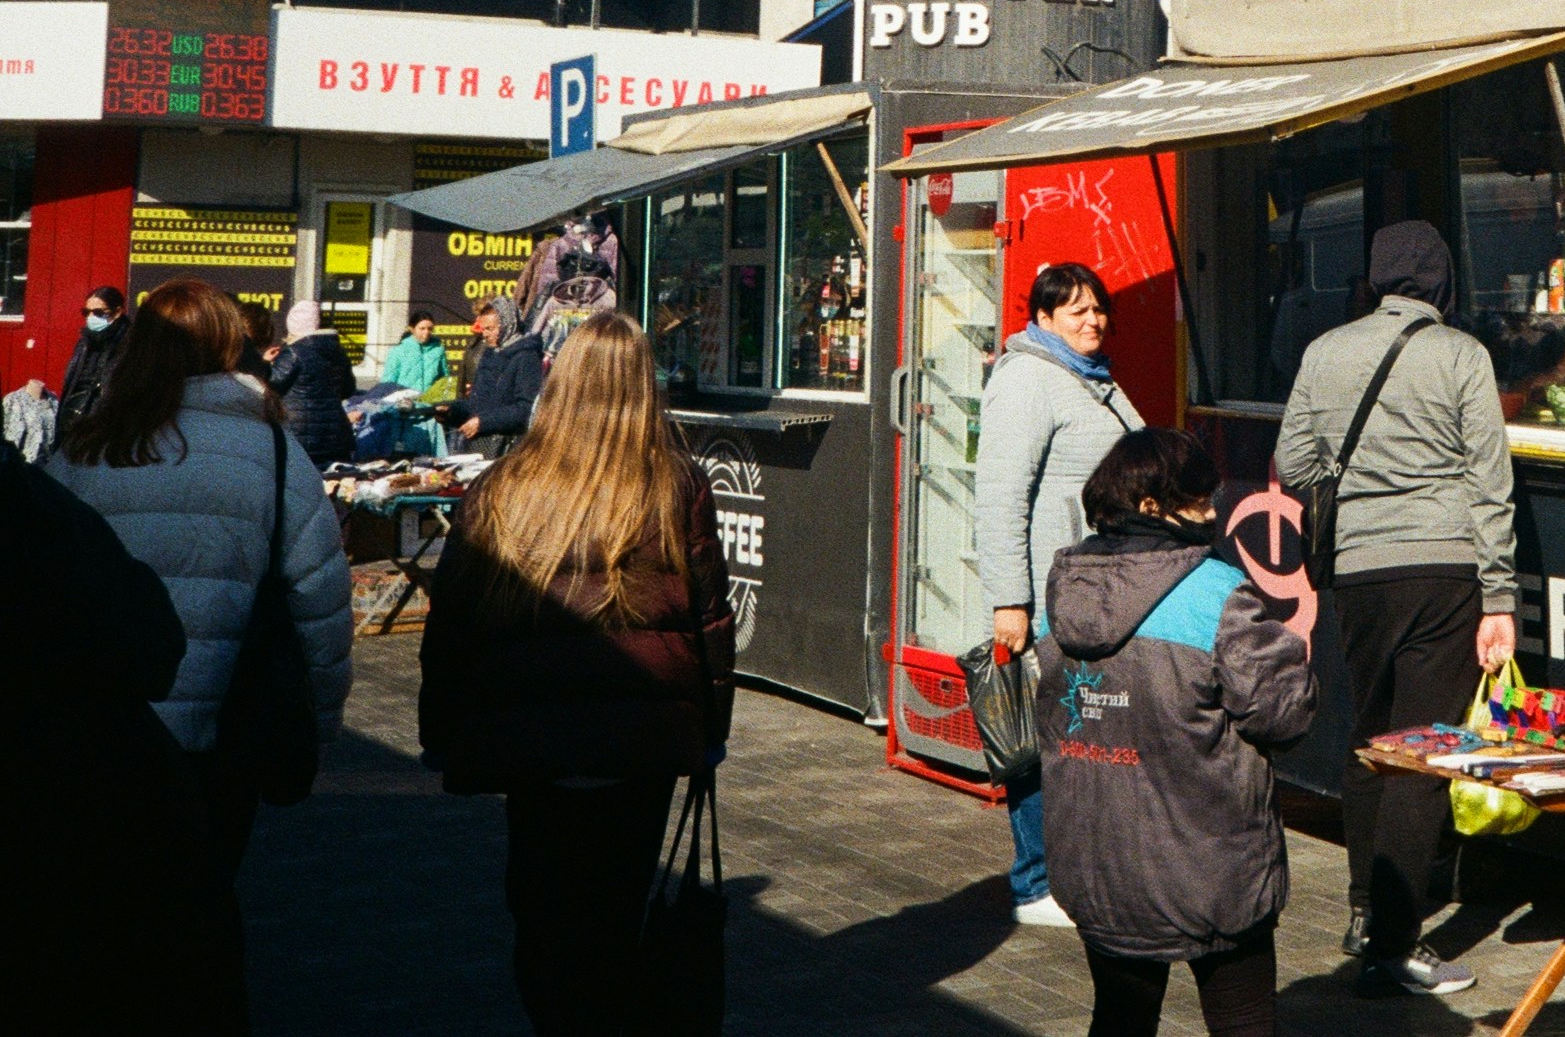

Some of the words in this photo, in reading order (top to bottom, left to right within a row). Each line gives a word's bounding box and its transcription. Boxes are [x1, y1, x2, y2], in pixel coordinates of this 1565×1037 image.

[870, 2, 992, 47] PUB
[172, 35, 203, 55] USD
[171, 64, 200, 85] EUR
[319, 59, 480, 97] ВЗУТТЯ
[498, 76, 515, 99] &
[169, 93, 200, 112] RUB
[560, 68, 587, 148] P
[448, 232, 532, 257] ОБМІН
